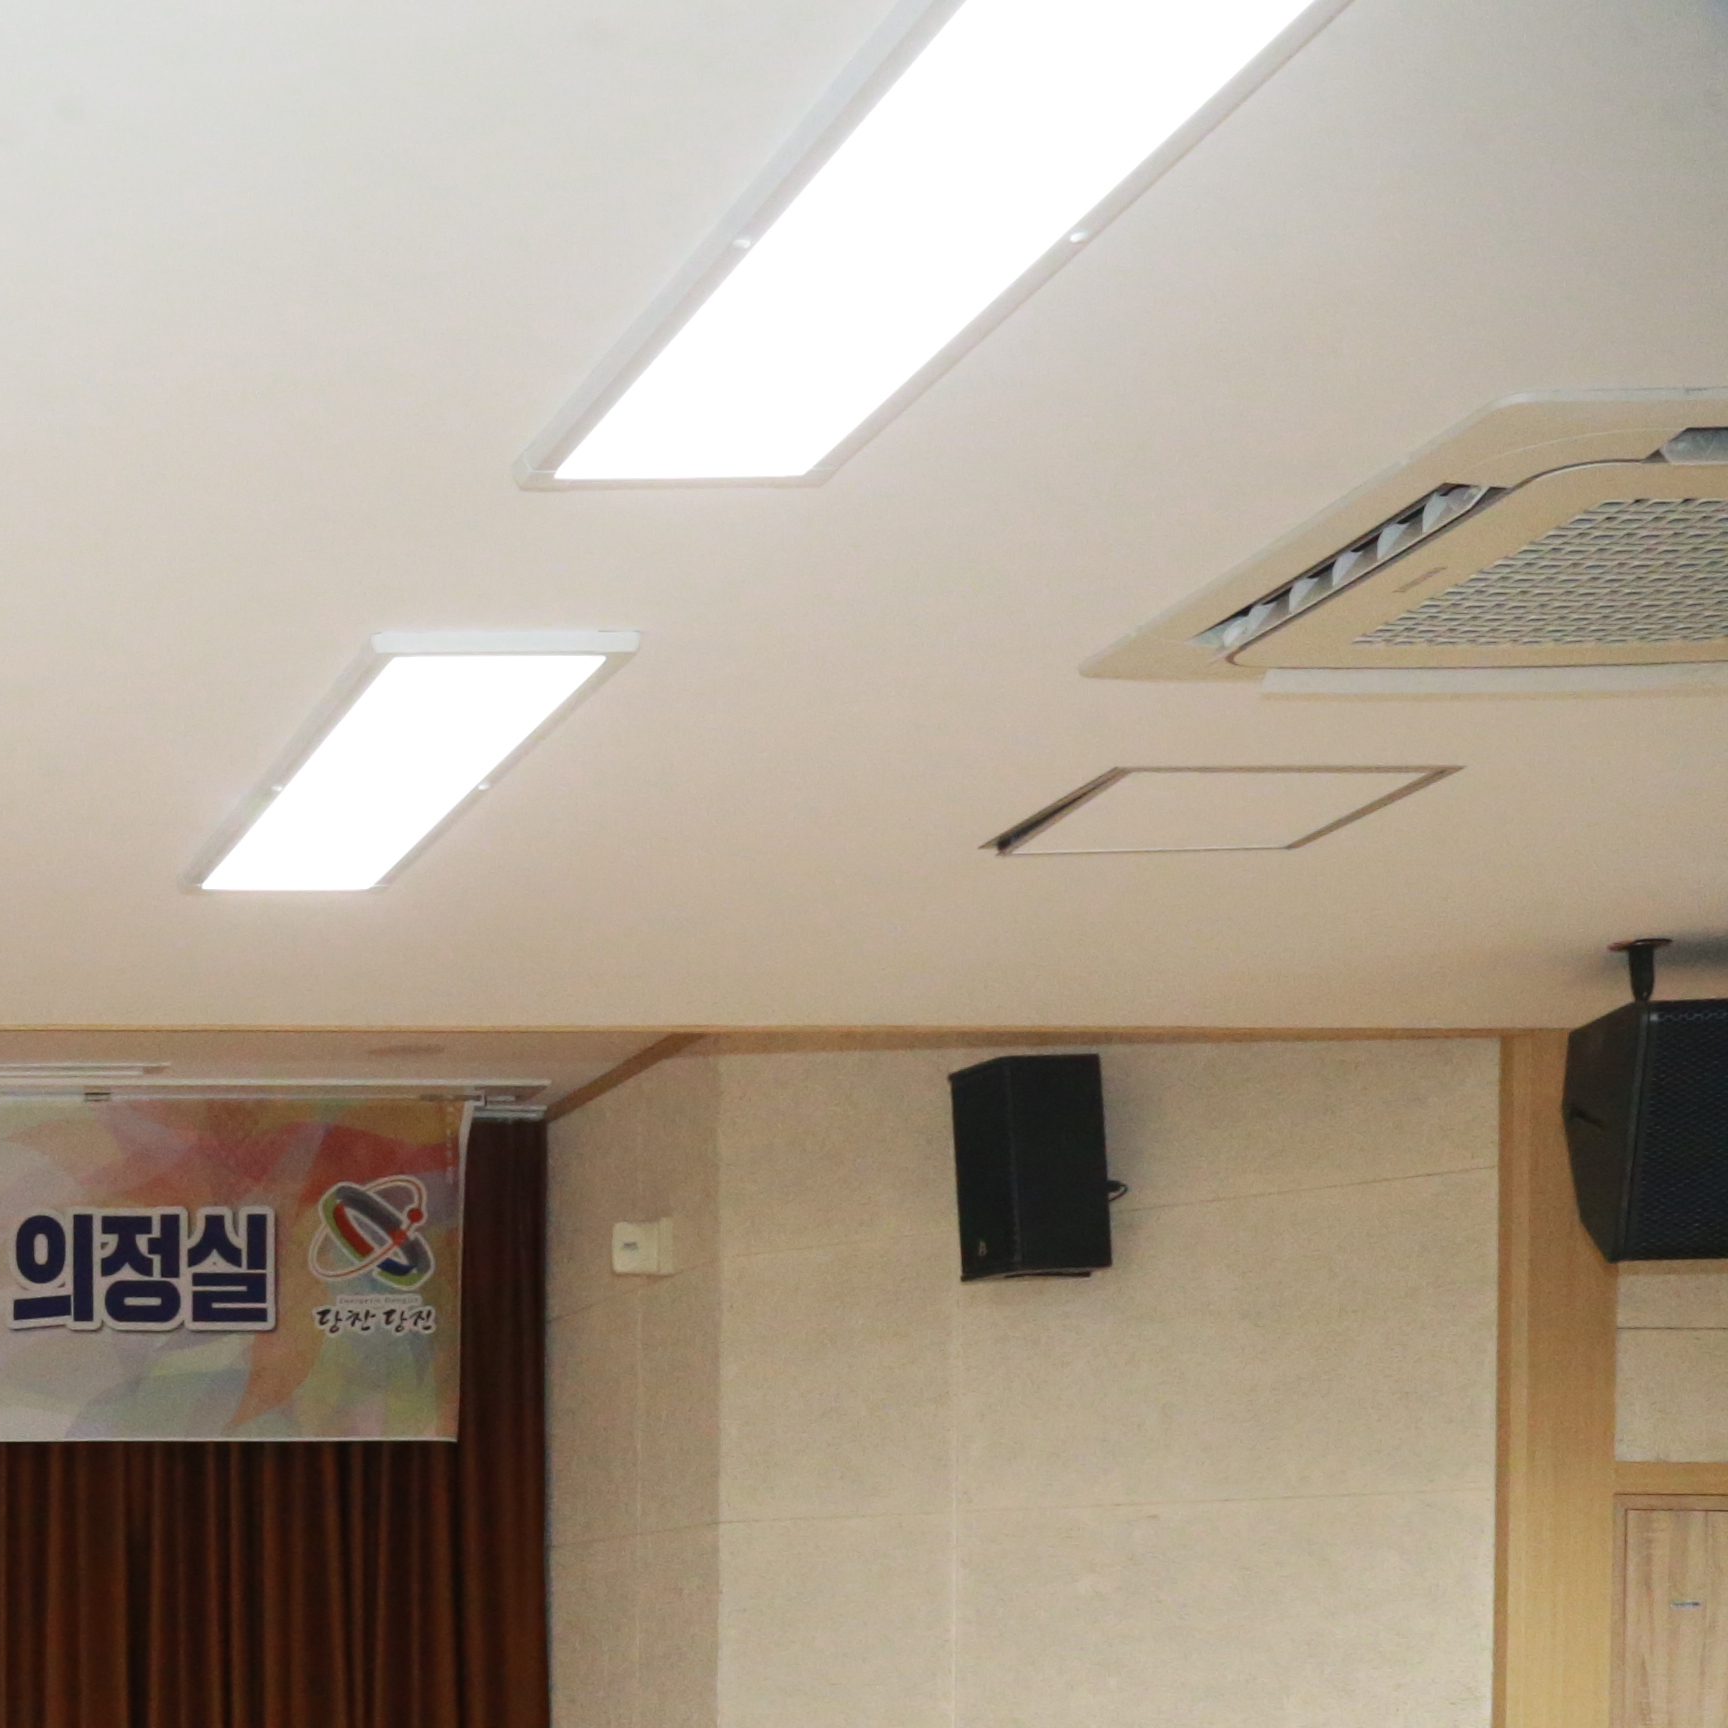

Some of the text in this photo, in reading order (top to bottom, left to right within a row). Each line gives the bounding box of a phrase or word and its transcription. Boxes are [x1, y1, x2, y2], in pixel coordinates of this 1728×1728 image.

[12, 1212, 269, 1324] 의정실
[315, 1308, 433, 1334] 당찬 당진
